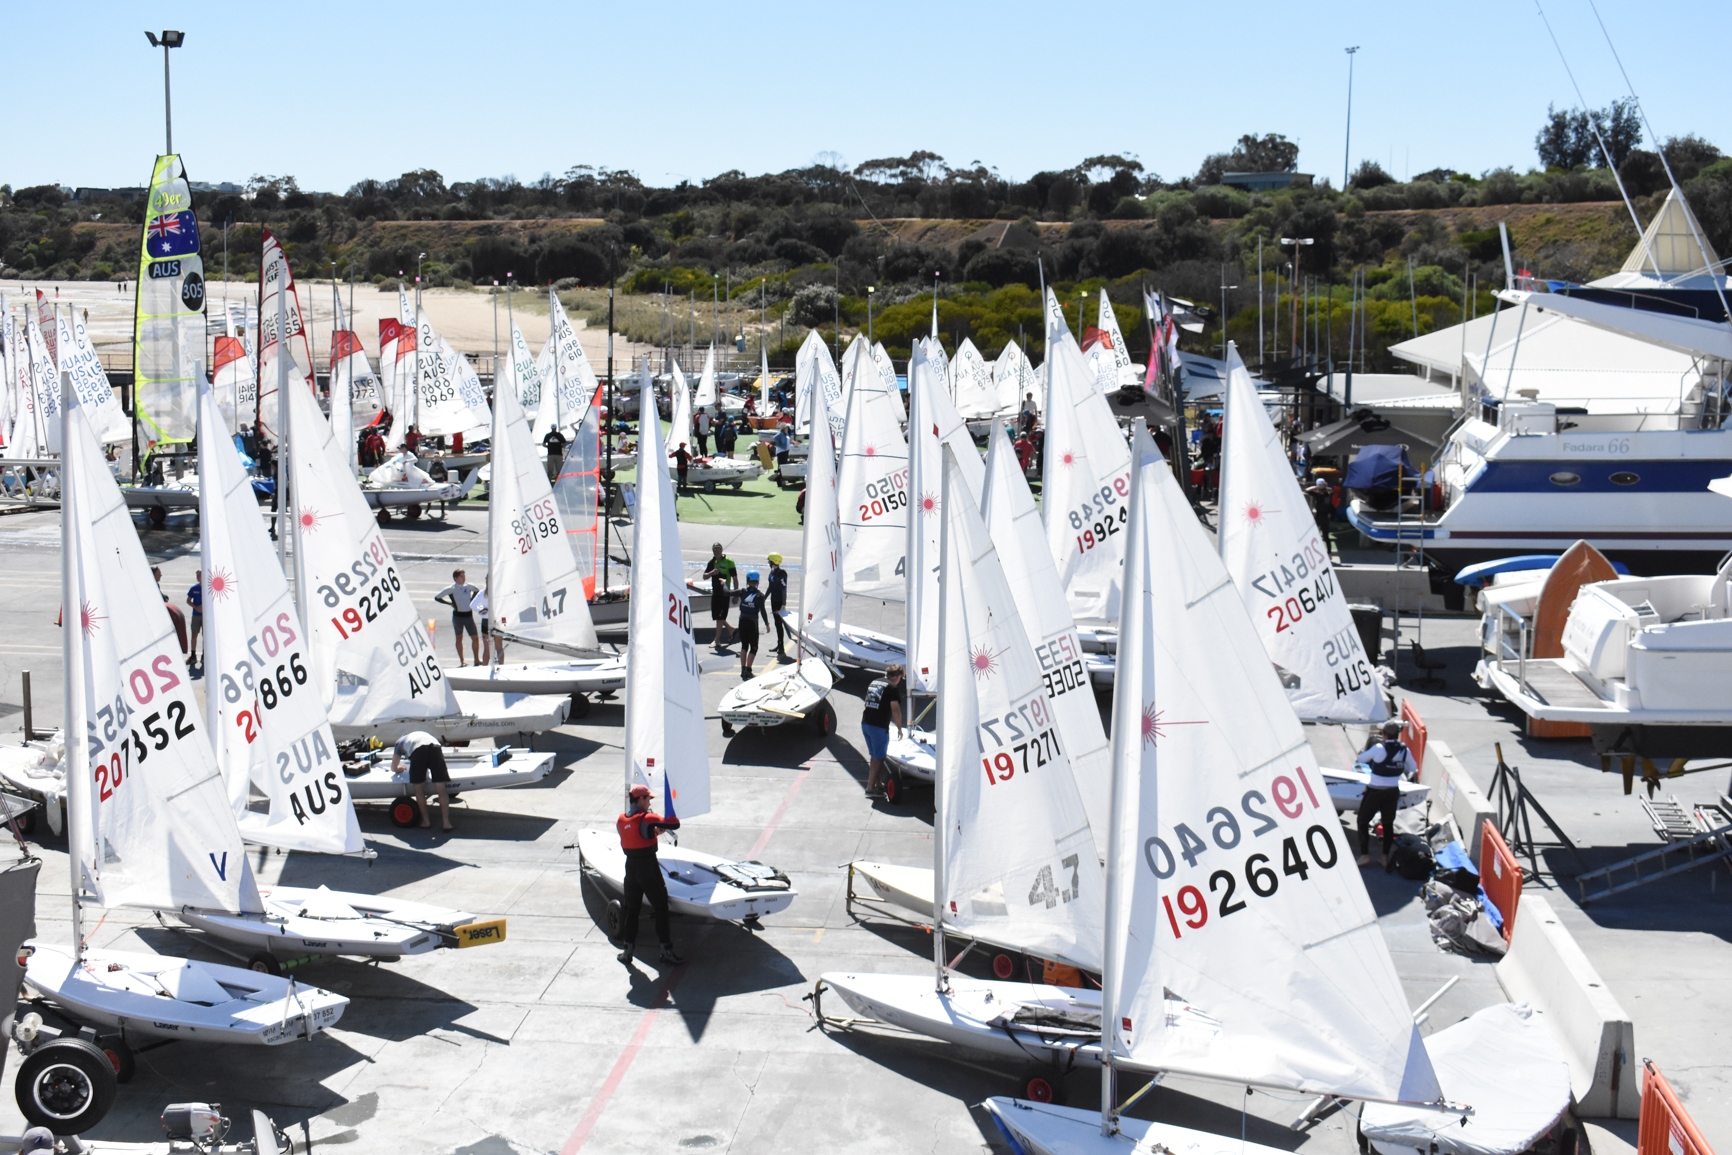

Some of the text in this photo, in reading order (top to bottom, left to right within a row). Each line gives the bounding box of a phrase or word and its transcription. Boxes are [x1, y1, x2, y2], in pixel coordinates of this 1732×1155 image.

[154, 191, 182, 208] 49er
[153, 261, 179, 277] AUS
[183, 282, 203, 300] 305
[568, 348, 583, 361] 610
[69, 365, 86, 382] US
[423, 362, 446, 382] AUS
[522, 366, 538, 384] AUS
[820, 373, 835, 385] US
[878, 365, 894, 378] AUS
[425, 387, 455, 408] 6969
[1563, 437, 1630, 455] Fadara 66
[859, 490, 907, 522] 20150
[331, 567, 401, 640] 192296
[542, 587, 567, 620] 4.7
[1267, 567, 1334, 633] 206417
[408, 655, 442, 700] AUS
[602, 677, 623, 685] Laser
[1335, 660, 1372, 700] AUS
[467, 720, 516, 728] northsails.com
[982, 727, 1061, 786] 197271
[289, 771, 342, 826] AUS
[209, 851, 228, 881] V
[1028, 852, 1080, 910] 4.7
[1161, 824, 1338, 940] 192640
[468, 926, 500, 941] Laser
[302, 939, 328, 948] Laser
[153, 1021, 179, 1031] Laser
